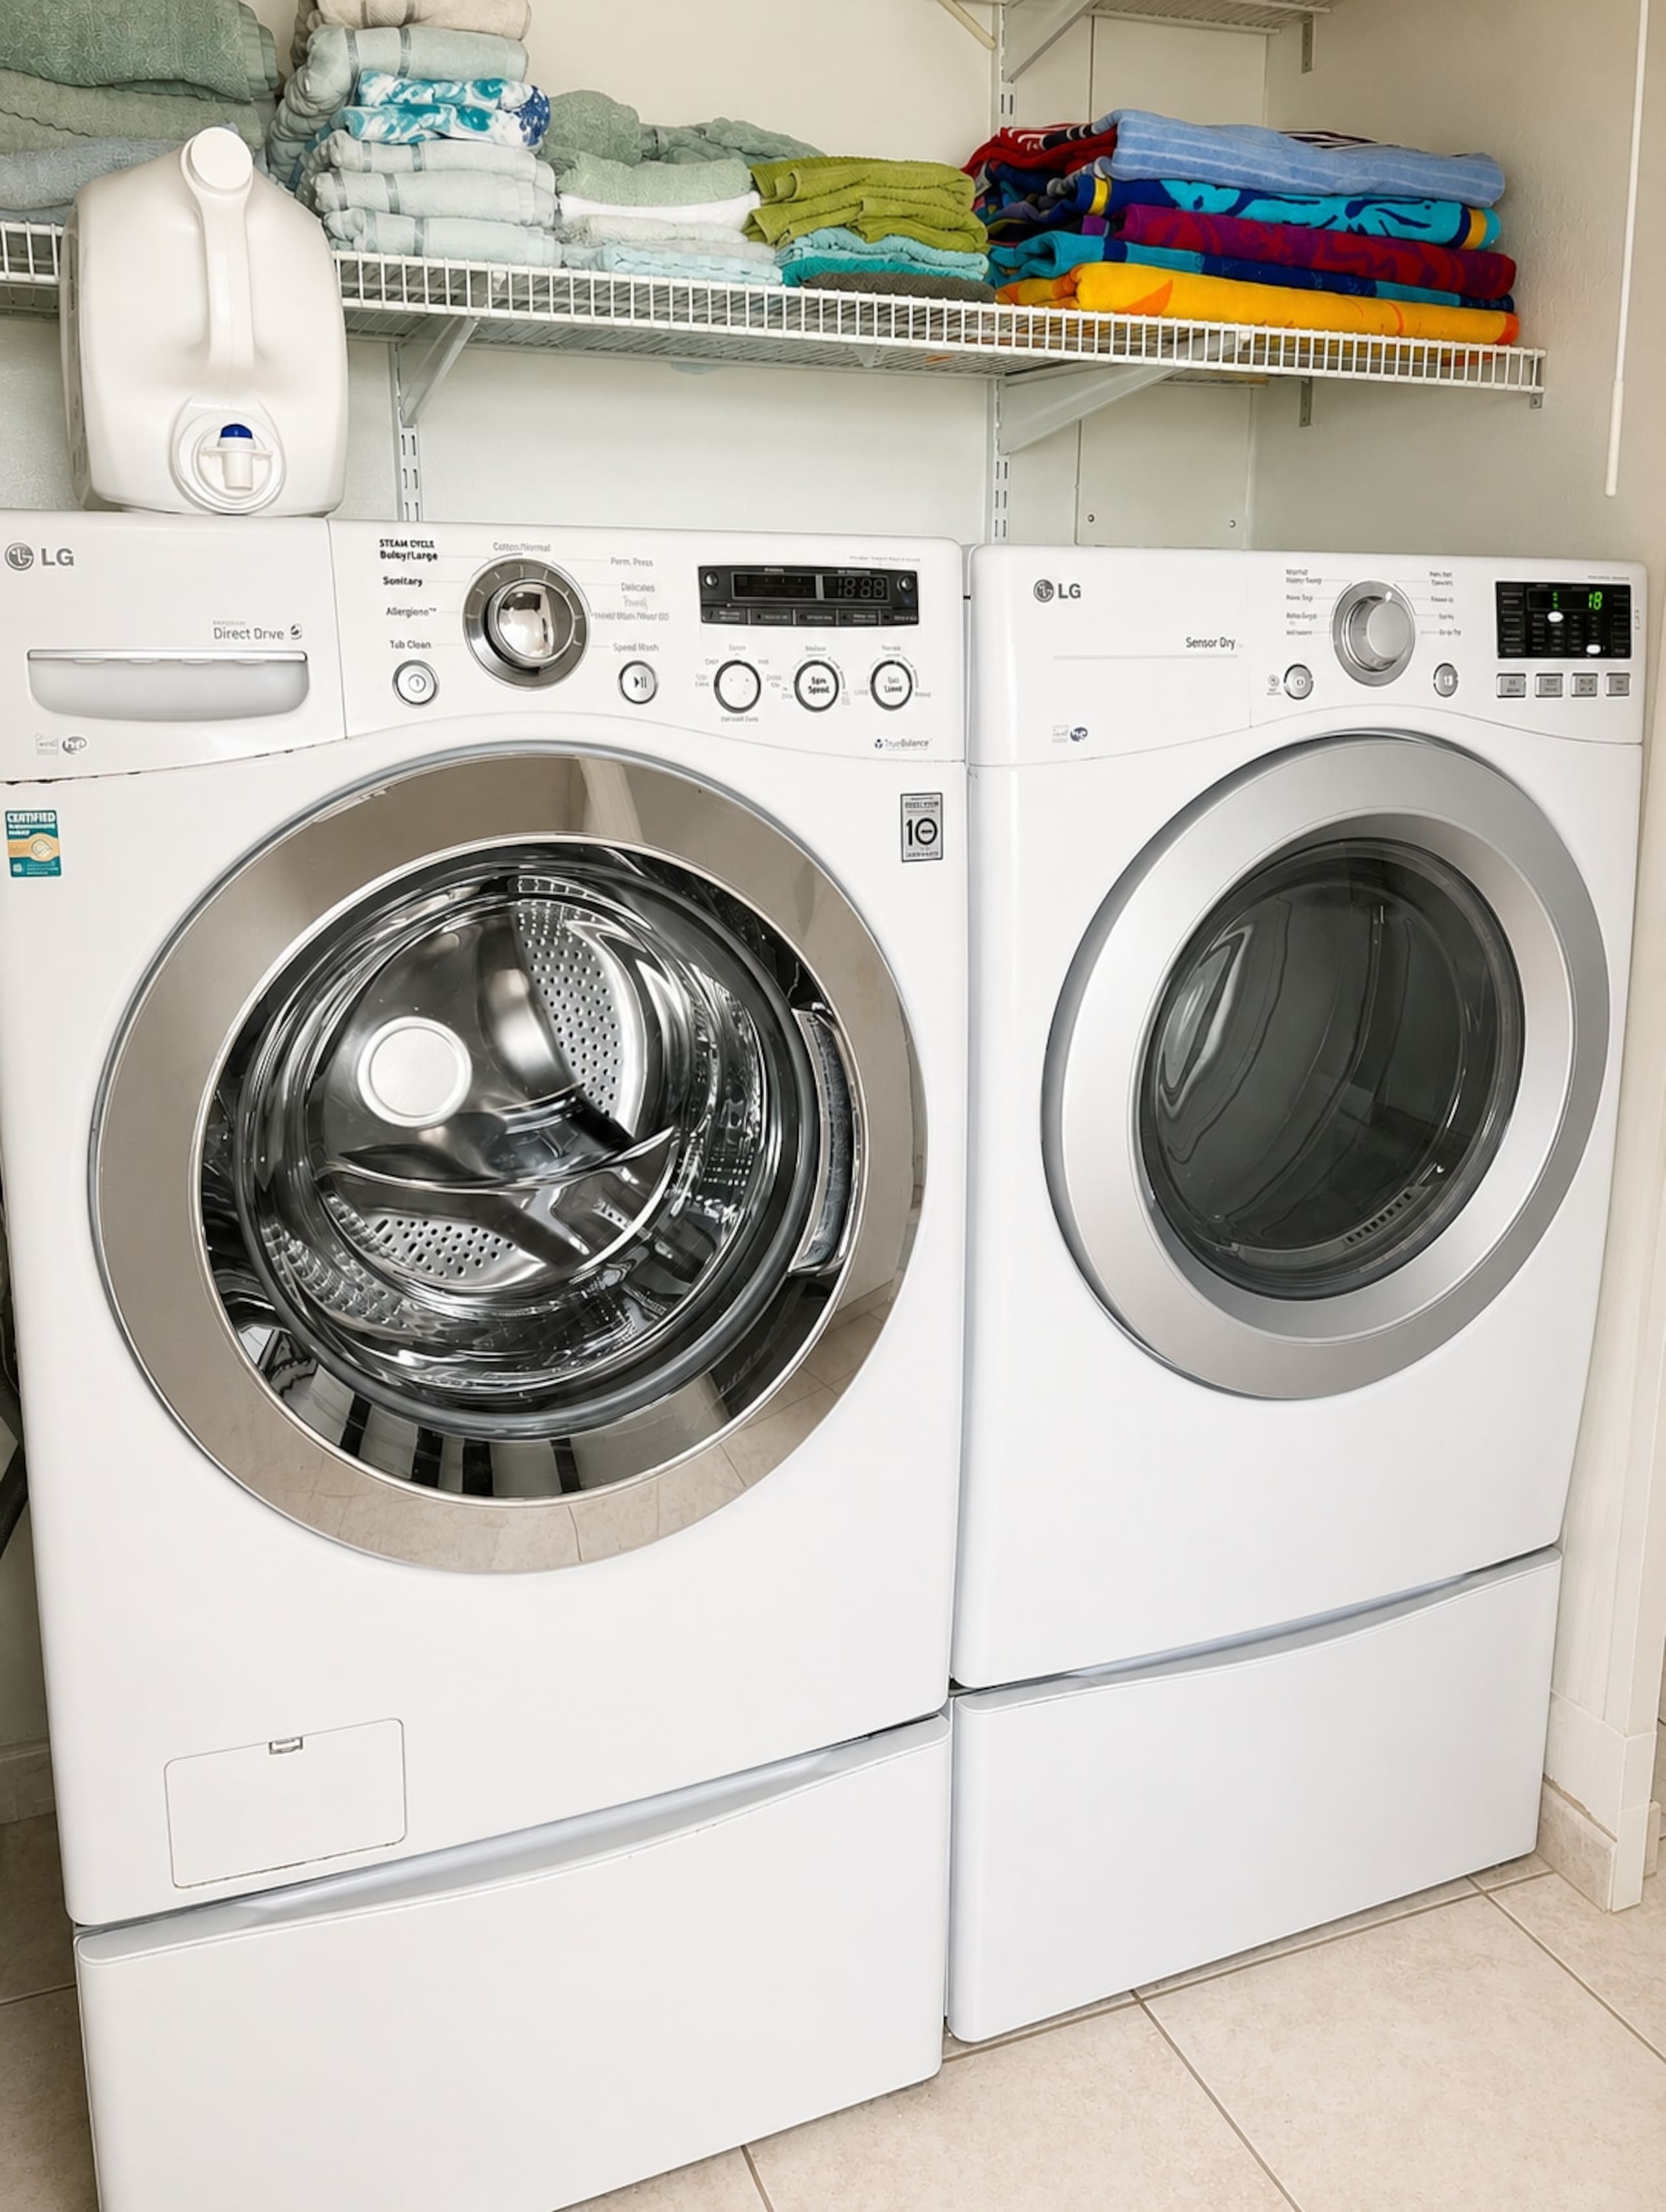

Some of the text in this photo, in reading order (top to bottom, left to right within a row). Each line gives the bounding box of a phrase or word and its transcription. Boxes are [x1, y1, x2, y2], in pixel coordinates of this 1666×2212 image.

[379, 539, 408, 548] STEAM
[40, 547, 75, 567] LG
[1058, 582, 1082, 599] LG
[213, 627, 284, 640] Direct Drive
[390, 639, 405, 649] Tub
[1186, 636, 1236, 651] Sensor Dry
